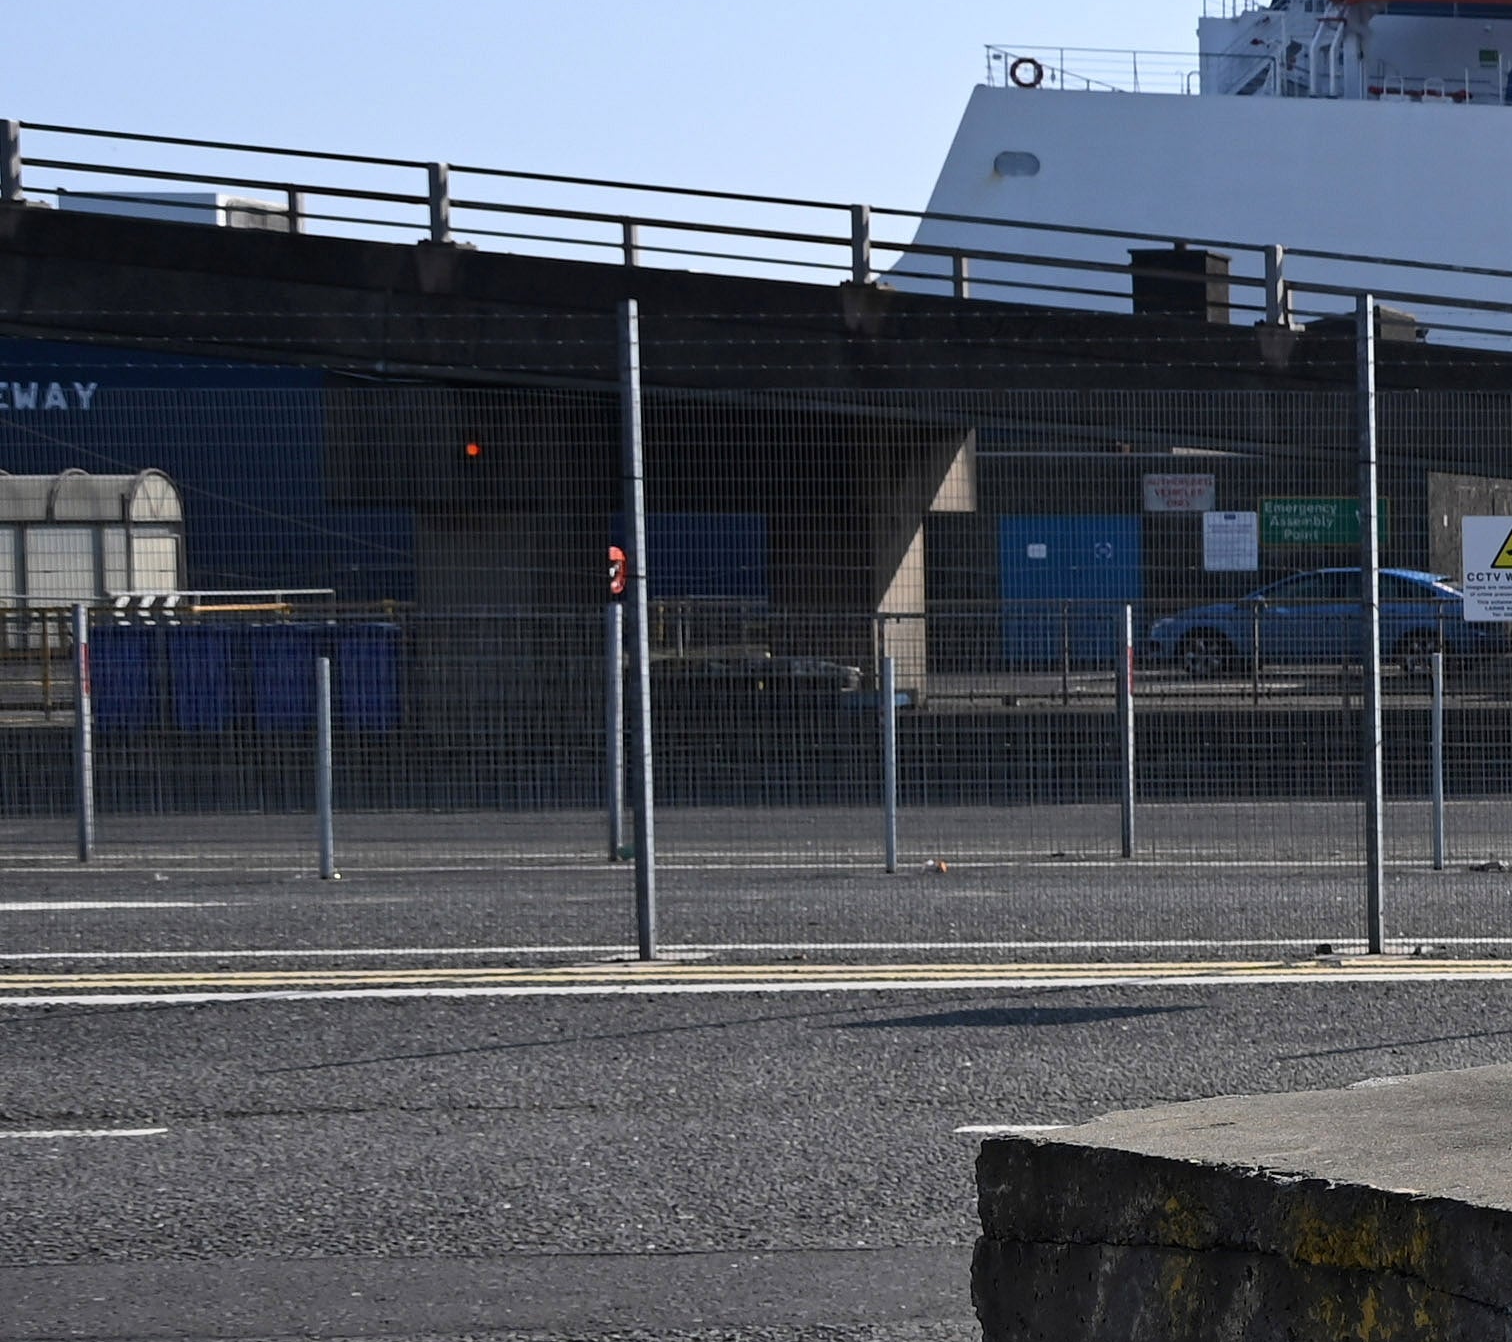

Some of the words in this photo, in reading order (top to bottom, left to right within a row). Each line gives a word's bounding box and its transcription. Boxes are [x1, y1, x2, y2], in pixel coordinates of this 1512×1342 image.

[1264, 501, 1337, 515] Emergency
[1270, 515, 1333, 529] Assembly
[1284, 529, 1319, 540] Point
[1467, 572, 1501, 582] CCTV
